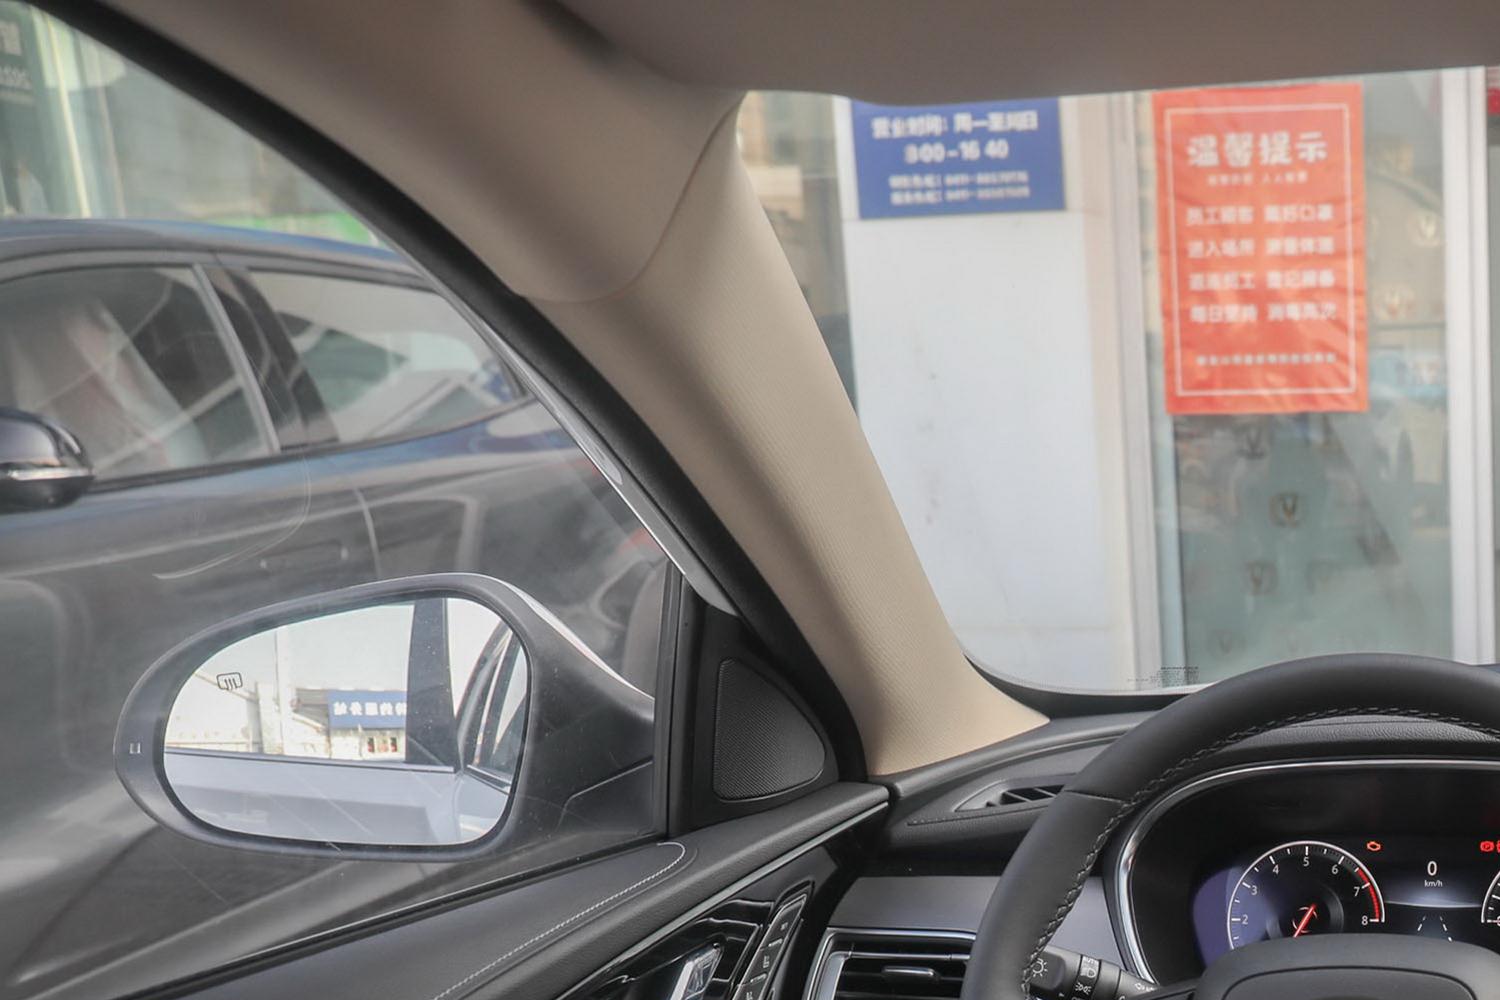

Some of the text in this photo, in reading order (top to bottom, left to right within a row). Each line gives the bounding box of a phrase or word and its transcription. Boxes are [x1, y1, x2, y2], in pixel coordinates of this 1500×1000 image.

[1187, 131, 1328, 168] 温馨提示
[1303, 856, 1310, 867] 5
[1272, 864, 1280, 875] 4
[1331, 864, 1339, 875] 6
[1427, 860, 1438, 876] 0
[1251, 885, 1258, 896] 3
[1353, 886, 1360, 897] 7
[1242, 915, 1249, 925] 2
[1361, 915, 1369, 926] 8
